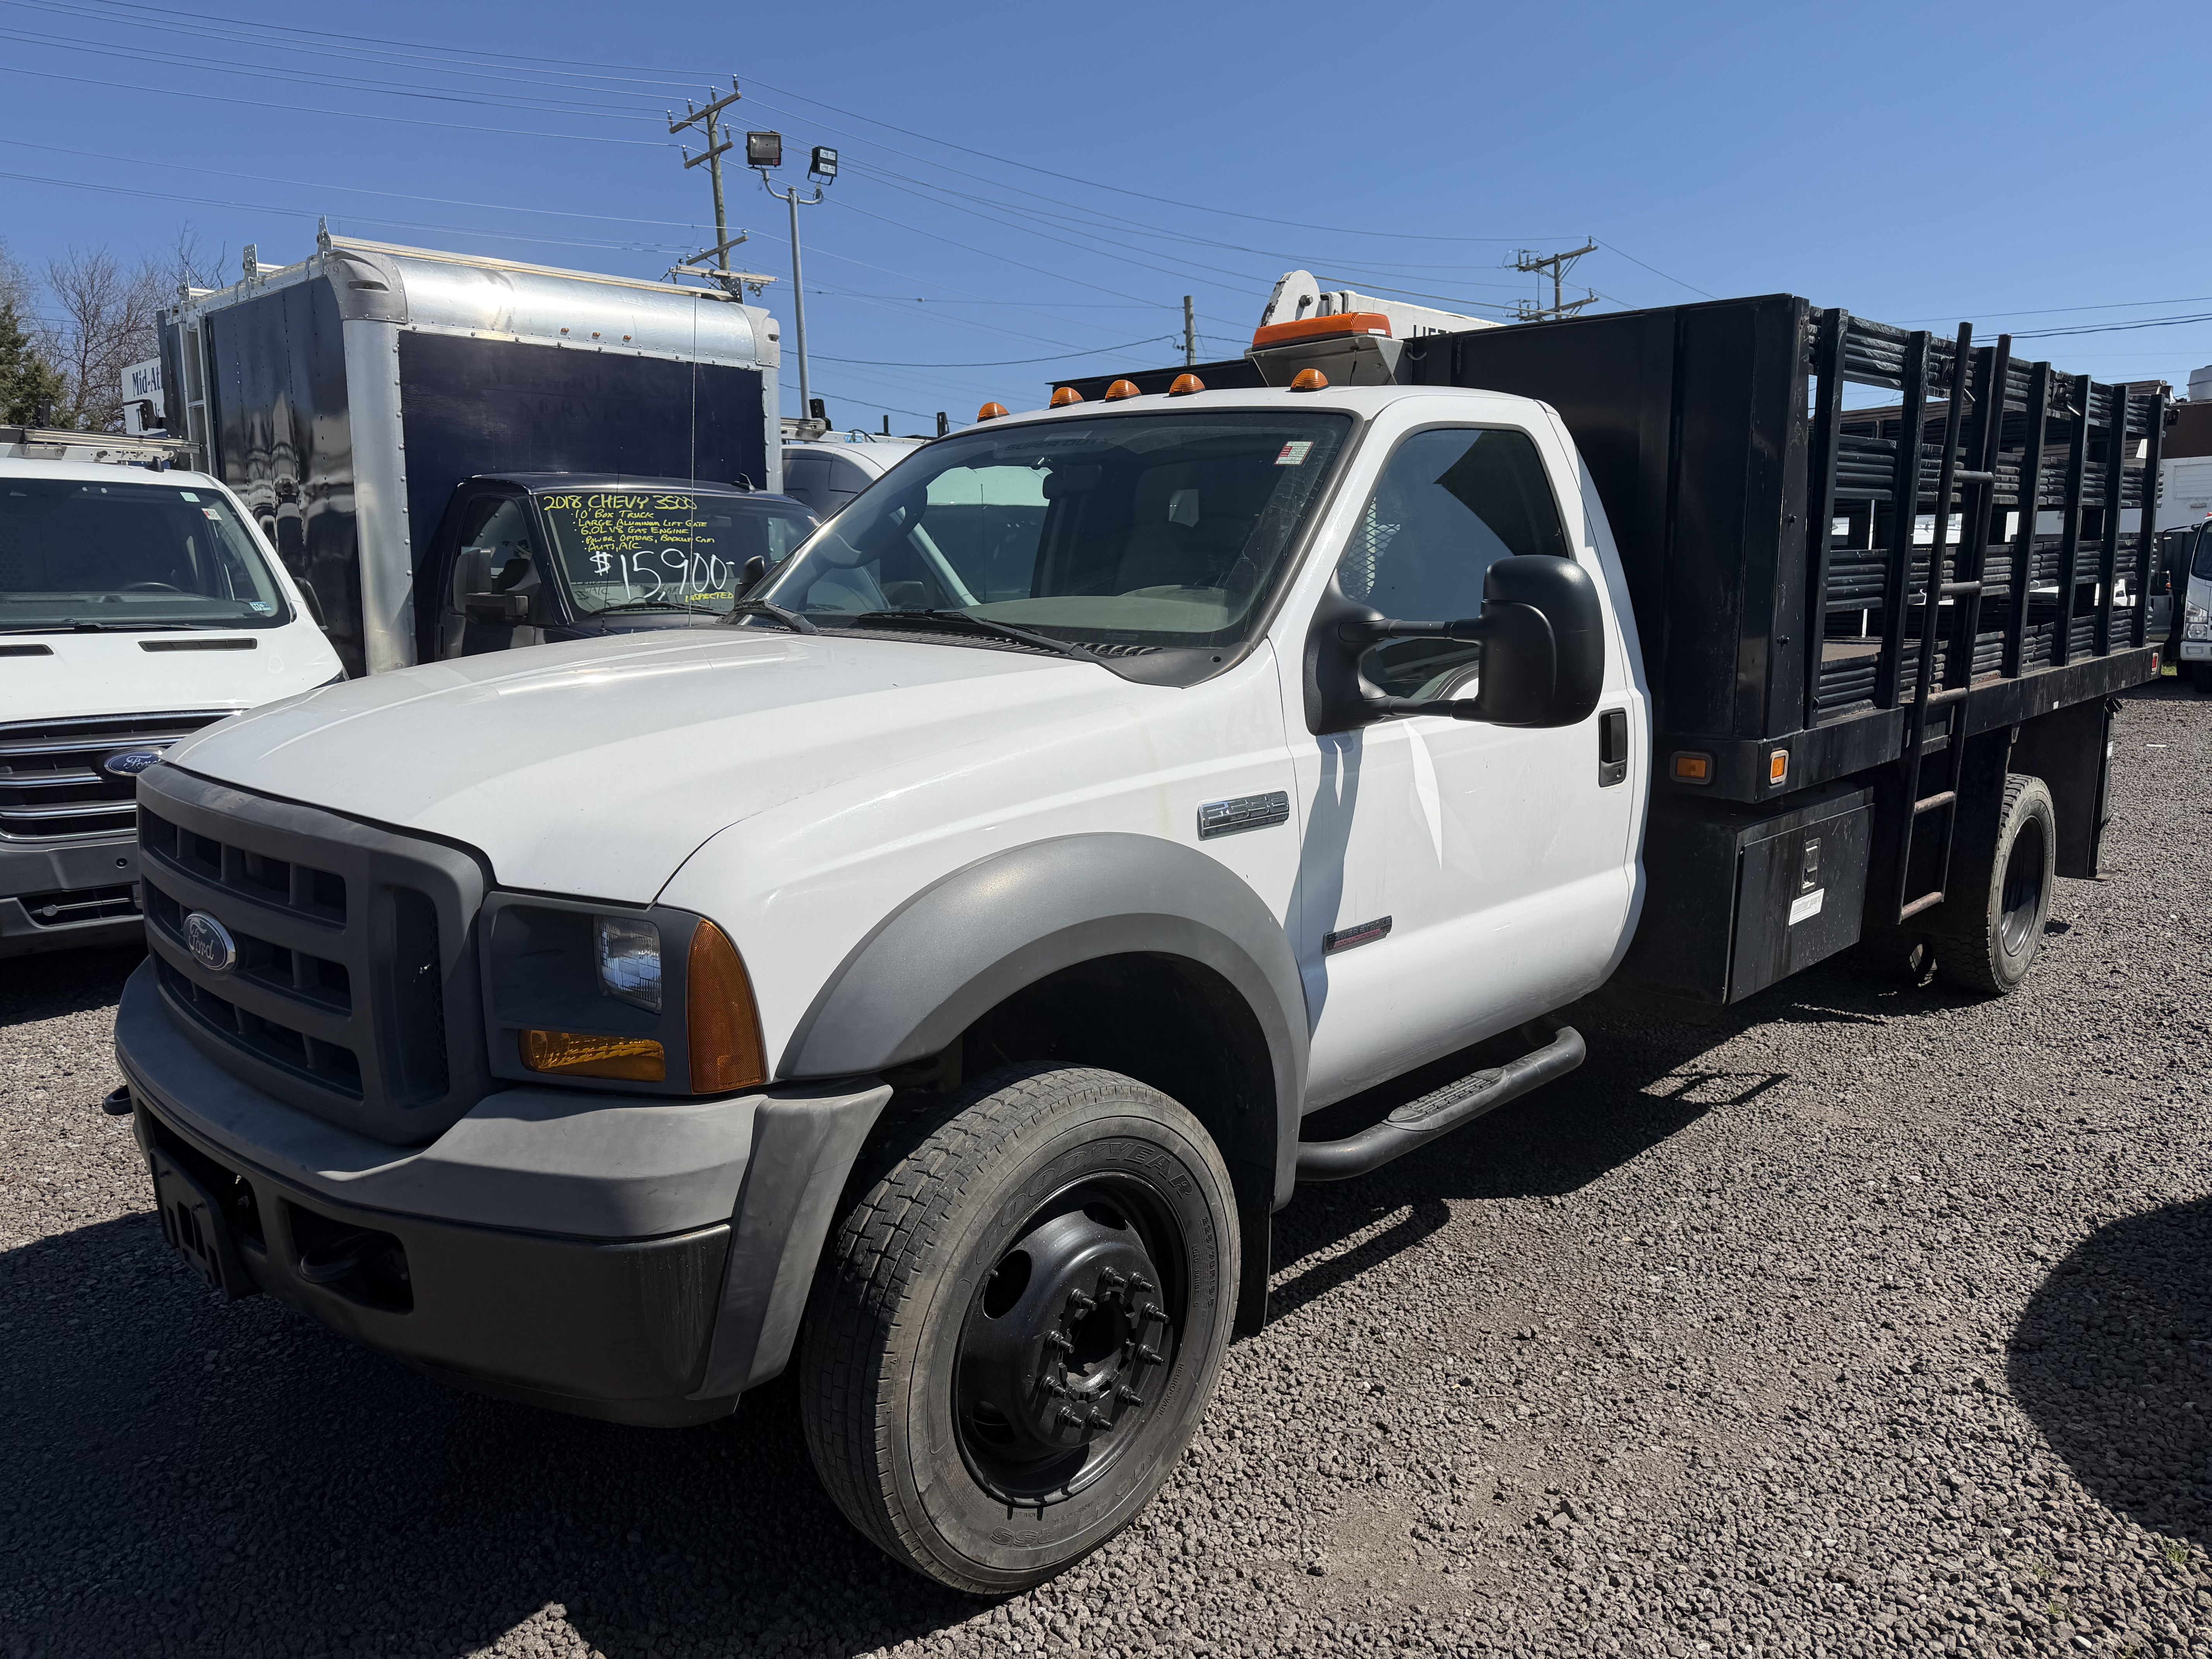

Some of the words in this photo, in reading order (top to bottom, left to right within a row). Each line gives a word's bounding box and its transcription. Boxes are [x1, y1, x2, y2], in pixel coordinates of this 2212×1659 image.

[132, 365, 161, 397] Mid-At
[1005, 440, 1059, 450] SUPER
[544, 495, 582, 510] 2018
[588, 494, 649, 509] CHEVY
[653, 495, 697, 510] 3500
[619, 510, 654, 519] TRUCK
[579, 518, 613, 527] LARGE
[617, 518, 660, 527] ALUMINUM
[581, 526, 608, 535] 6.0L
[685, 592, 734, 603] INSPECTED
[1328, 928, 1358, 941] POWER
[1360, 917, 1391, 933] STROKE
[189, 918, 214, 960] Ford
[975, 1142, 1193, 1265] GOODYEAR
